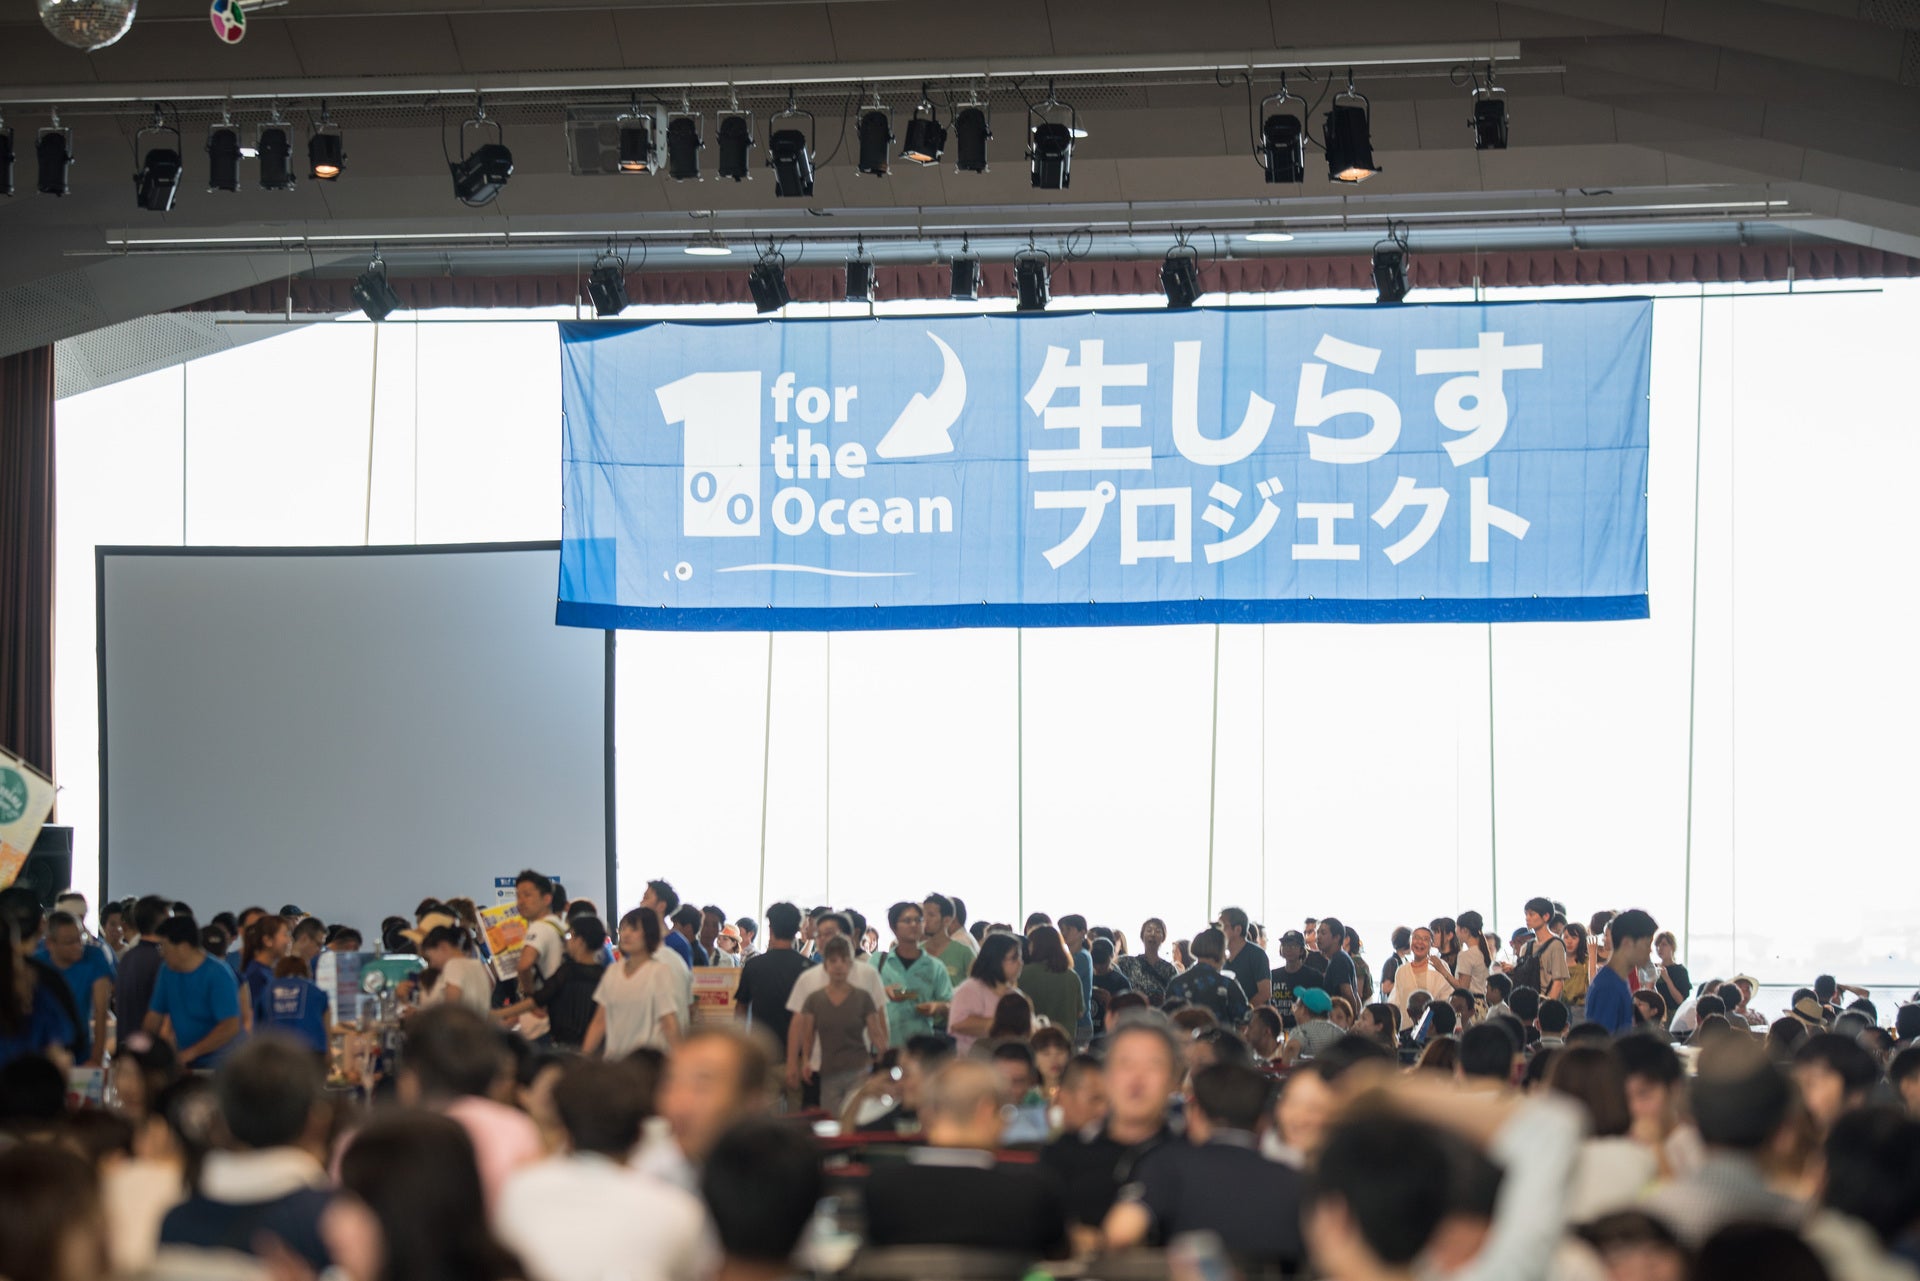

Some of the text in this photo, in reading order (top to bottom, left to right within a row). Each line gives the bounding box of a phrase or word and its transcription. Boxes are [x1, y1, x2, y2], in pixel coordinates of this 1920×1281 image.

[771, 372, 857, 423] for
[1024, 332, 1543, 472] 生しらす
[771, 429, 867, 479] the
[771, 486, 953, 536] Ocean
[1033, 476, 1531, 570] プロジェクト
